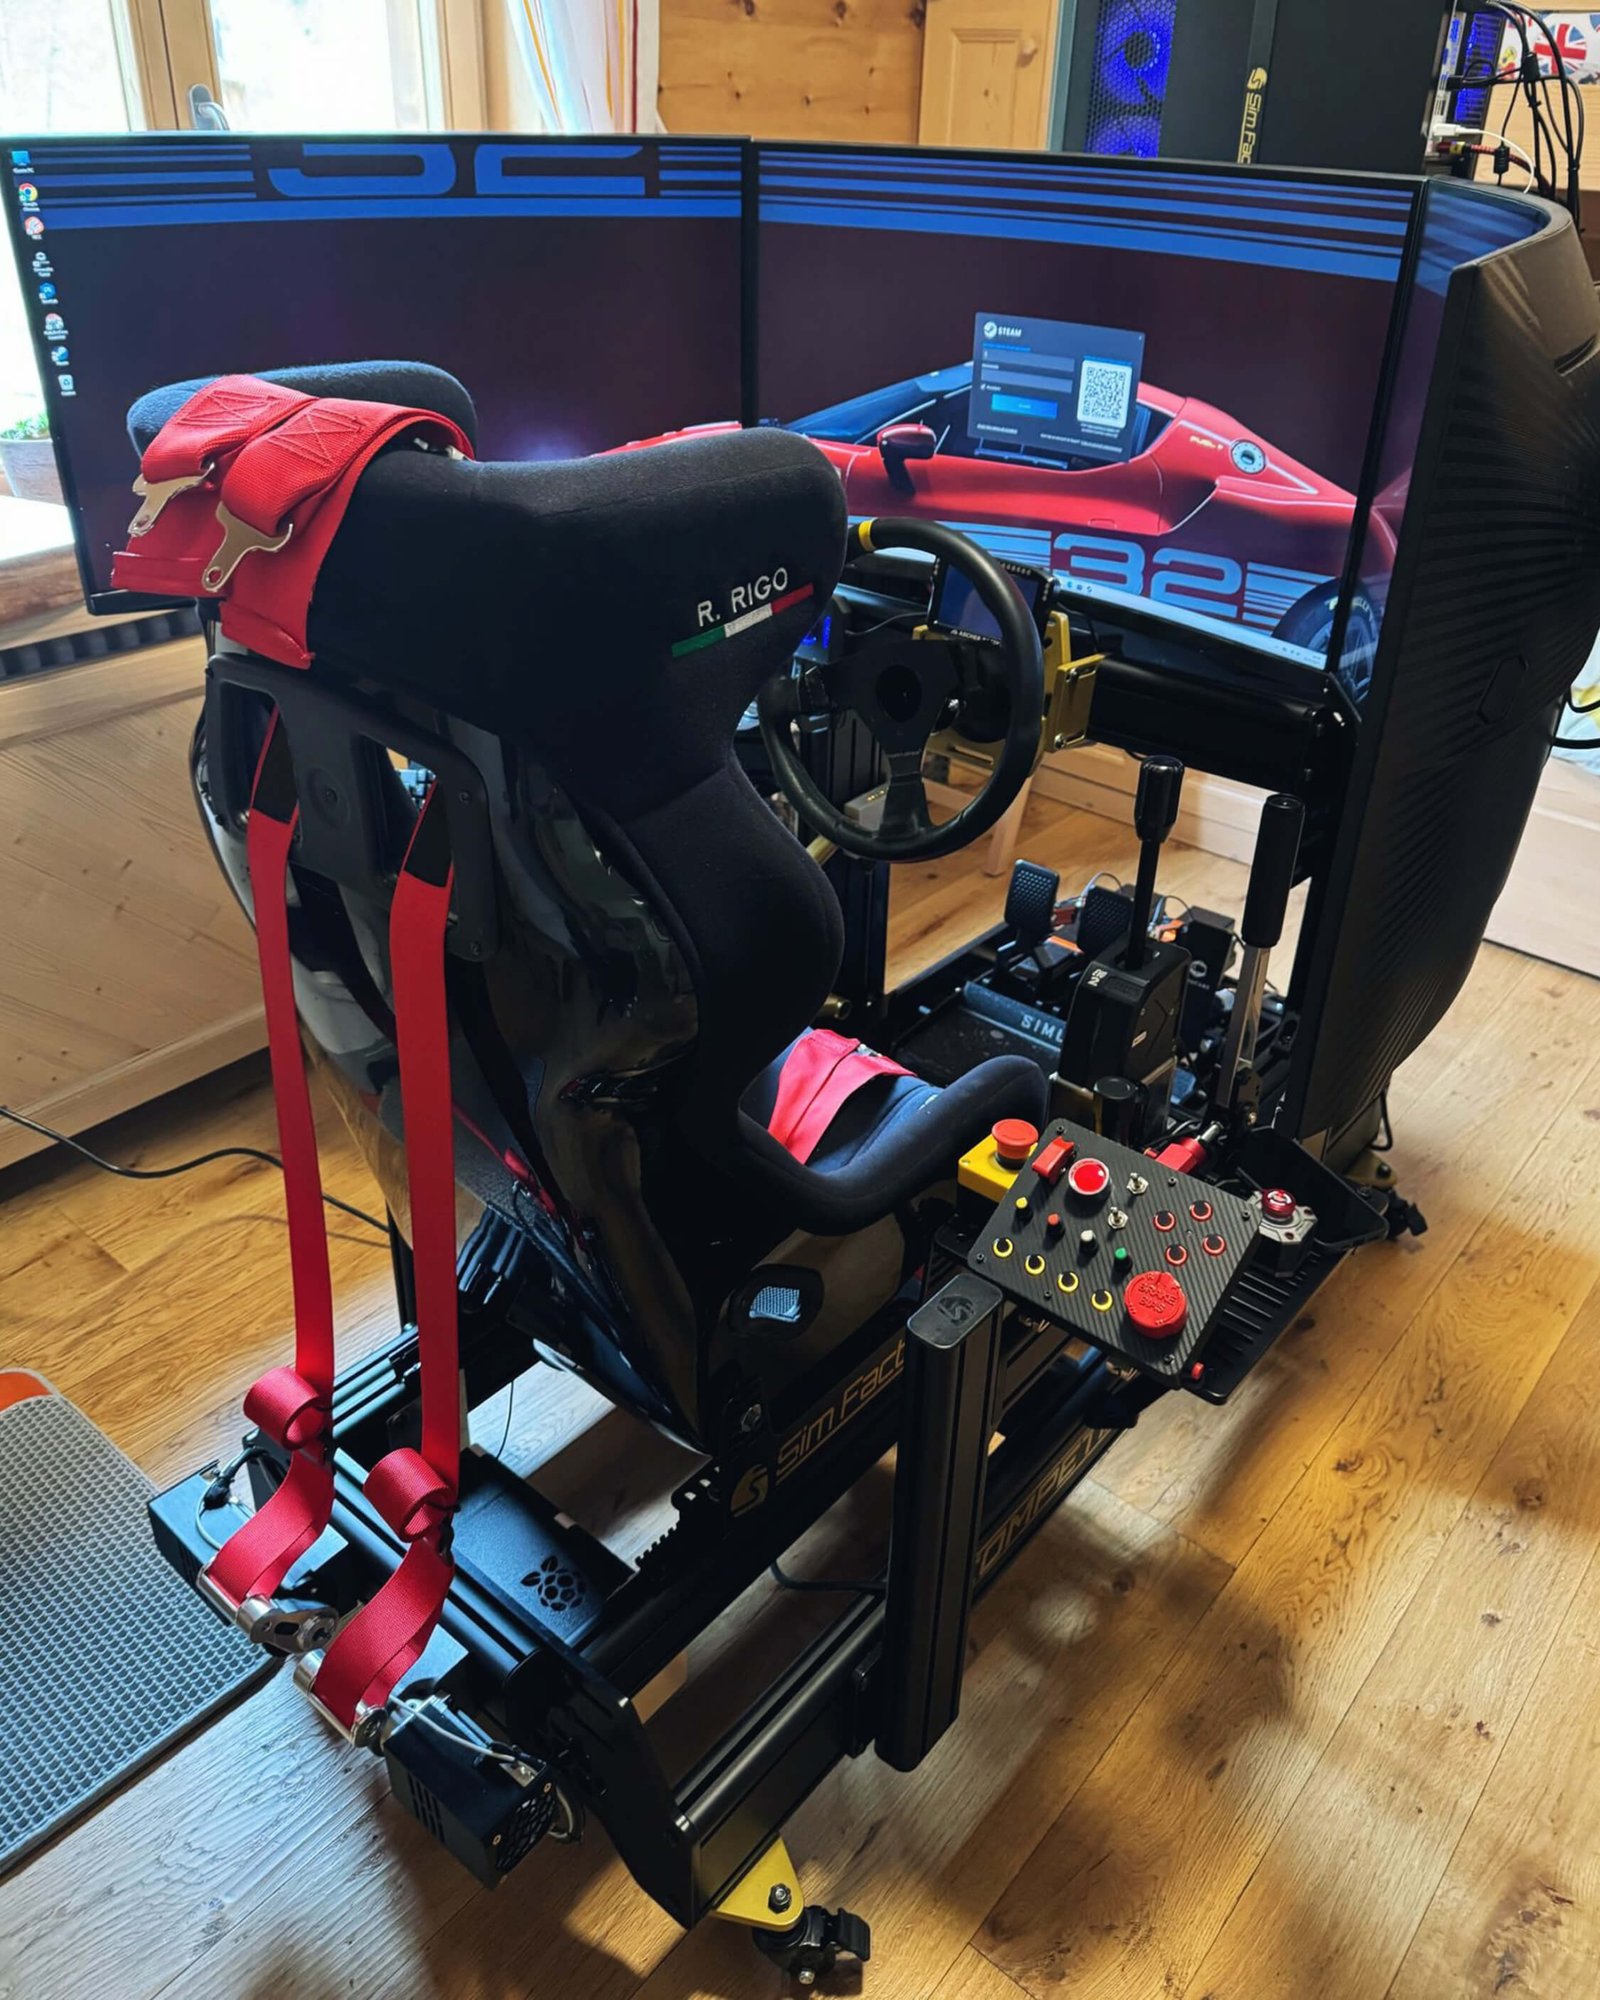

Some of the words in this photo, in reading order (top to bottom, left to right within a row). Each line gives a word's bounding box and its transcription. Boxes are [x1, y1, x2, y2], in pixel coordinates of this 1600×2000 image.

[998, 327, 1022, 337] STEAM
[1053, 532, 1242, 618] 32
[696, 599, 721, 627] R.
[731, 567, 788, 613] RIGO
[1138, 1283, 1177, 1306] BRAKE
[1139, 1296, 1165, 1313] BIAS
[776, 1406, 835, 1478] Sim
